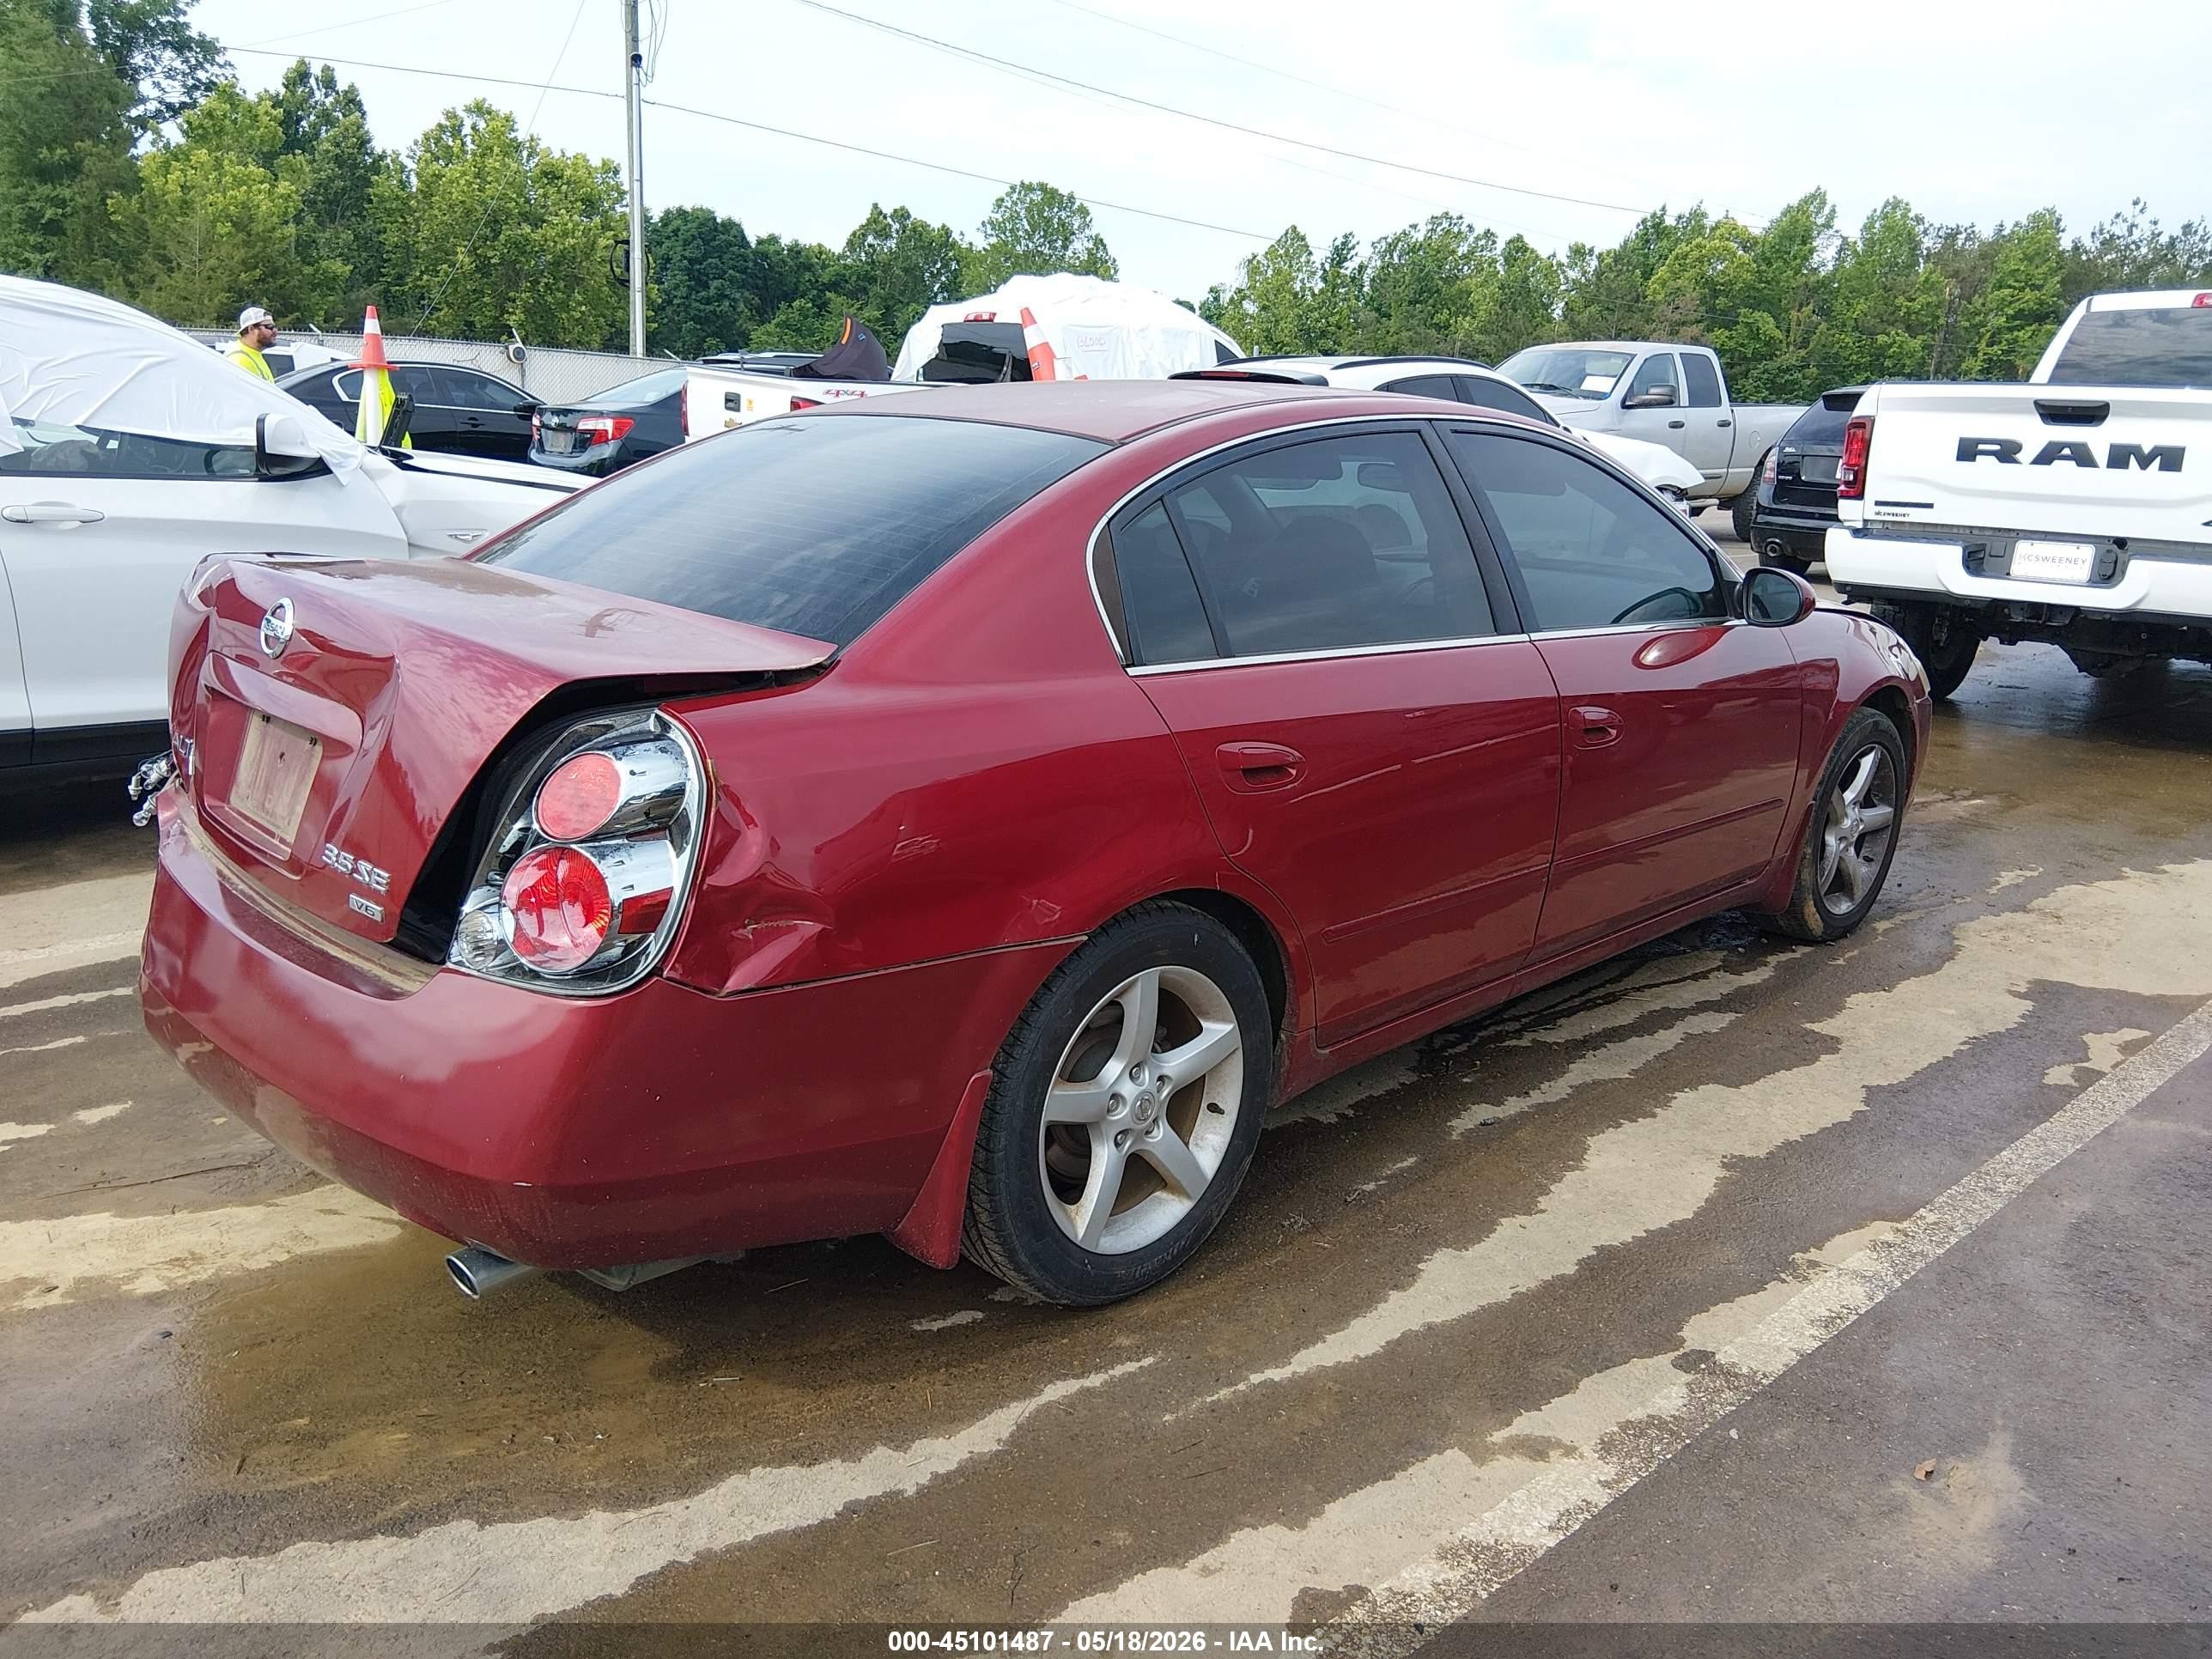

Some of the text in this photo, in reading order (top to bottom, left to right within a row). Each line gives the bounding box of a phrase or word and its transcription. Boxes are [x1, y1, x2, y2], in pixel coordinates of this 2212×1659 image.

[1956, 436, 2186, 472] RAM
[353, 860, 392, 894] SE
[353, 897, 375, 917] V6
